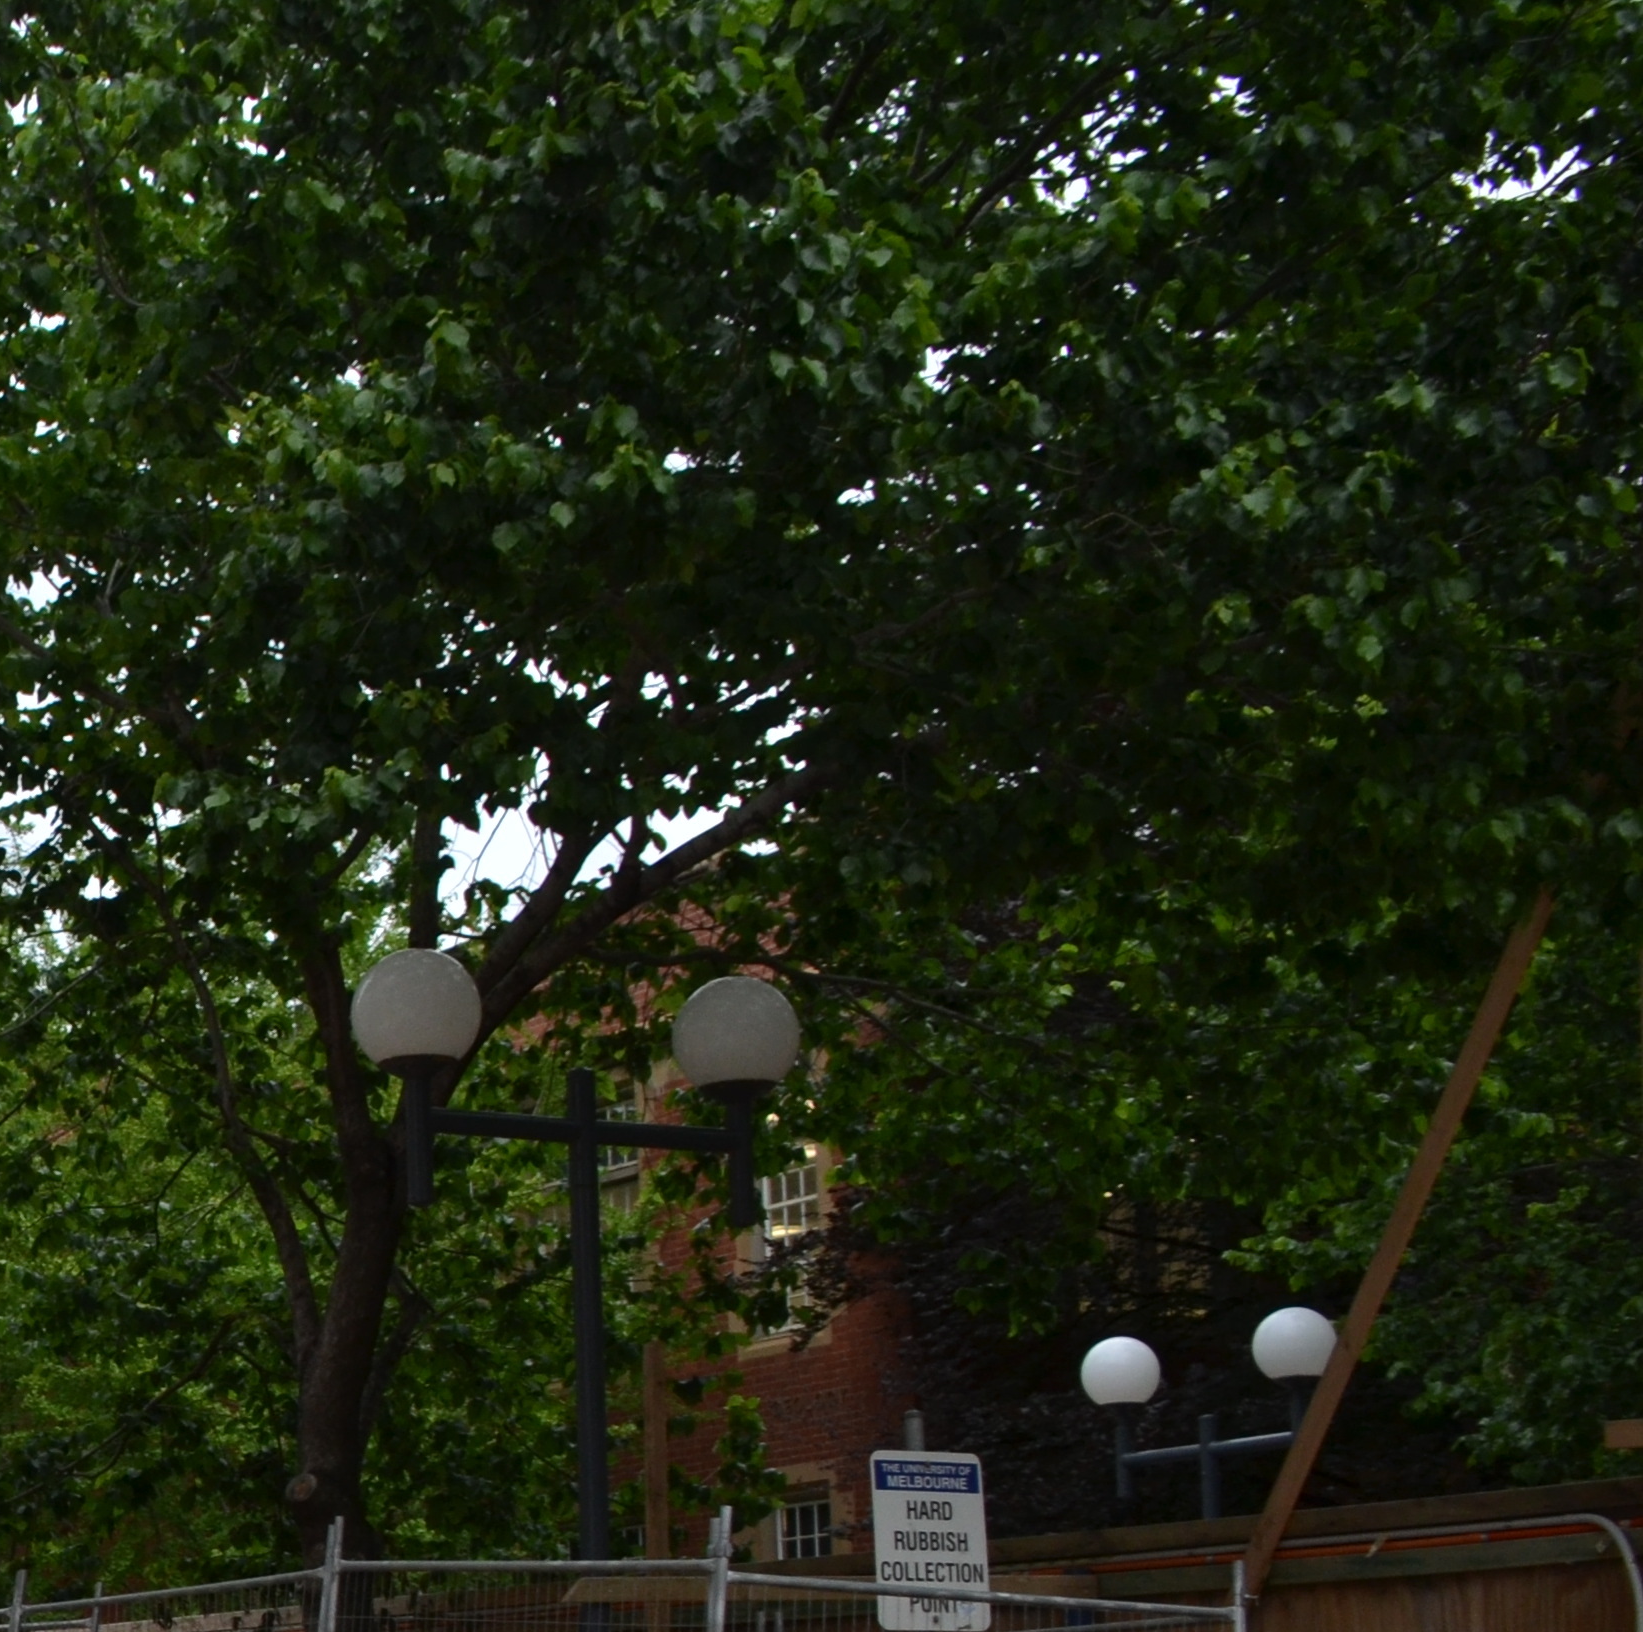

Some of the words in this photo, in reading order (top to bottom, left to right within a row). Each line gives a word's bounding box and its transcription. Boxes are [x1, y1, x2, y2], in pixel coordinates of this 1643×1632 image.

[881, 1463, 899, 1473] THE
[902, 1464, 956, 1475] UNIVERSITY
[959, 1466, 971, 1475] OF
[886, 1475, 968, 1490] MELBOURNE
[906, 1500, 953, 1521] HARD
[893, 1530, 968, 1552] RUBBISH
[880, 1561, 984, 1583] COLLECTION
[909, 1597, 958, 1613] POINT
